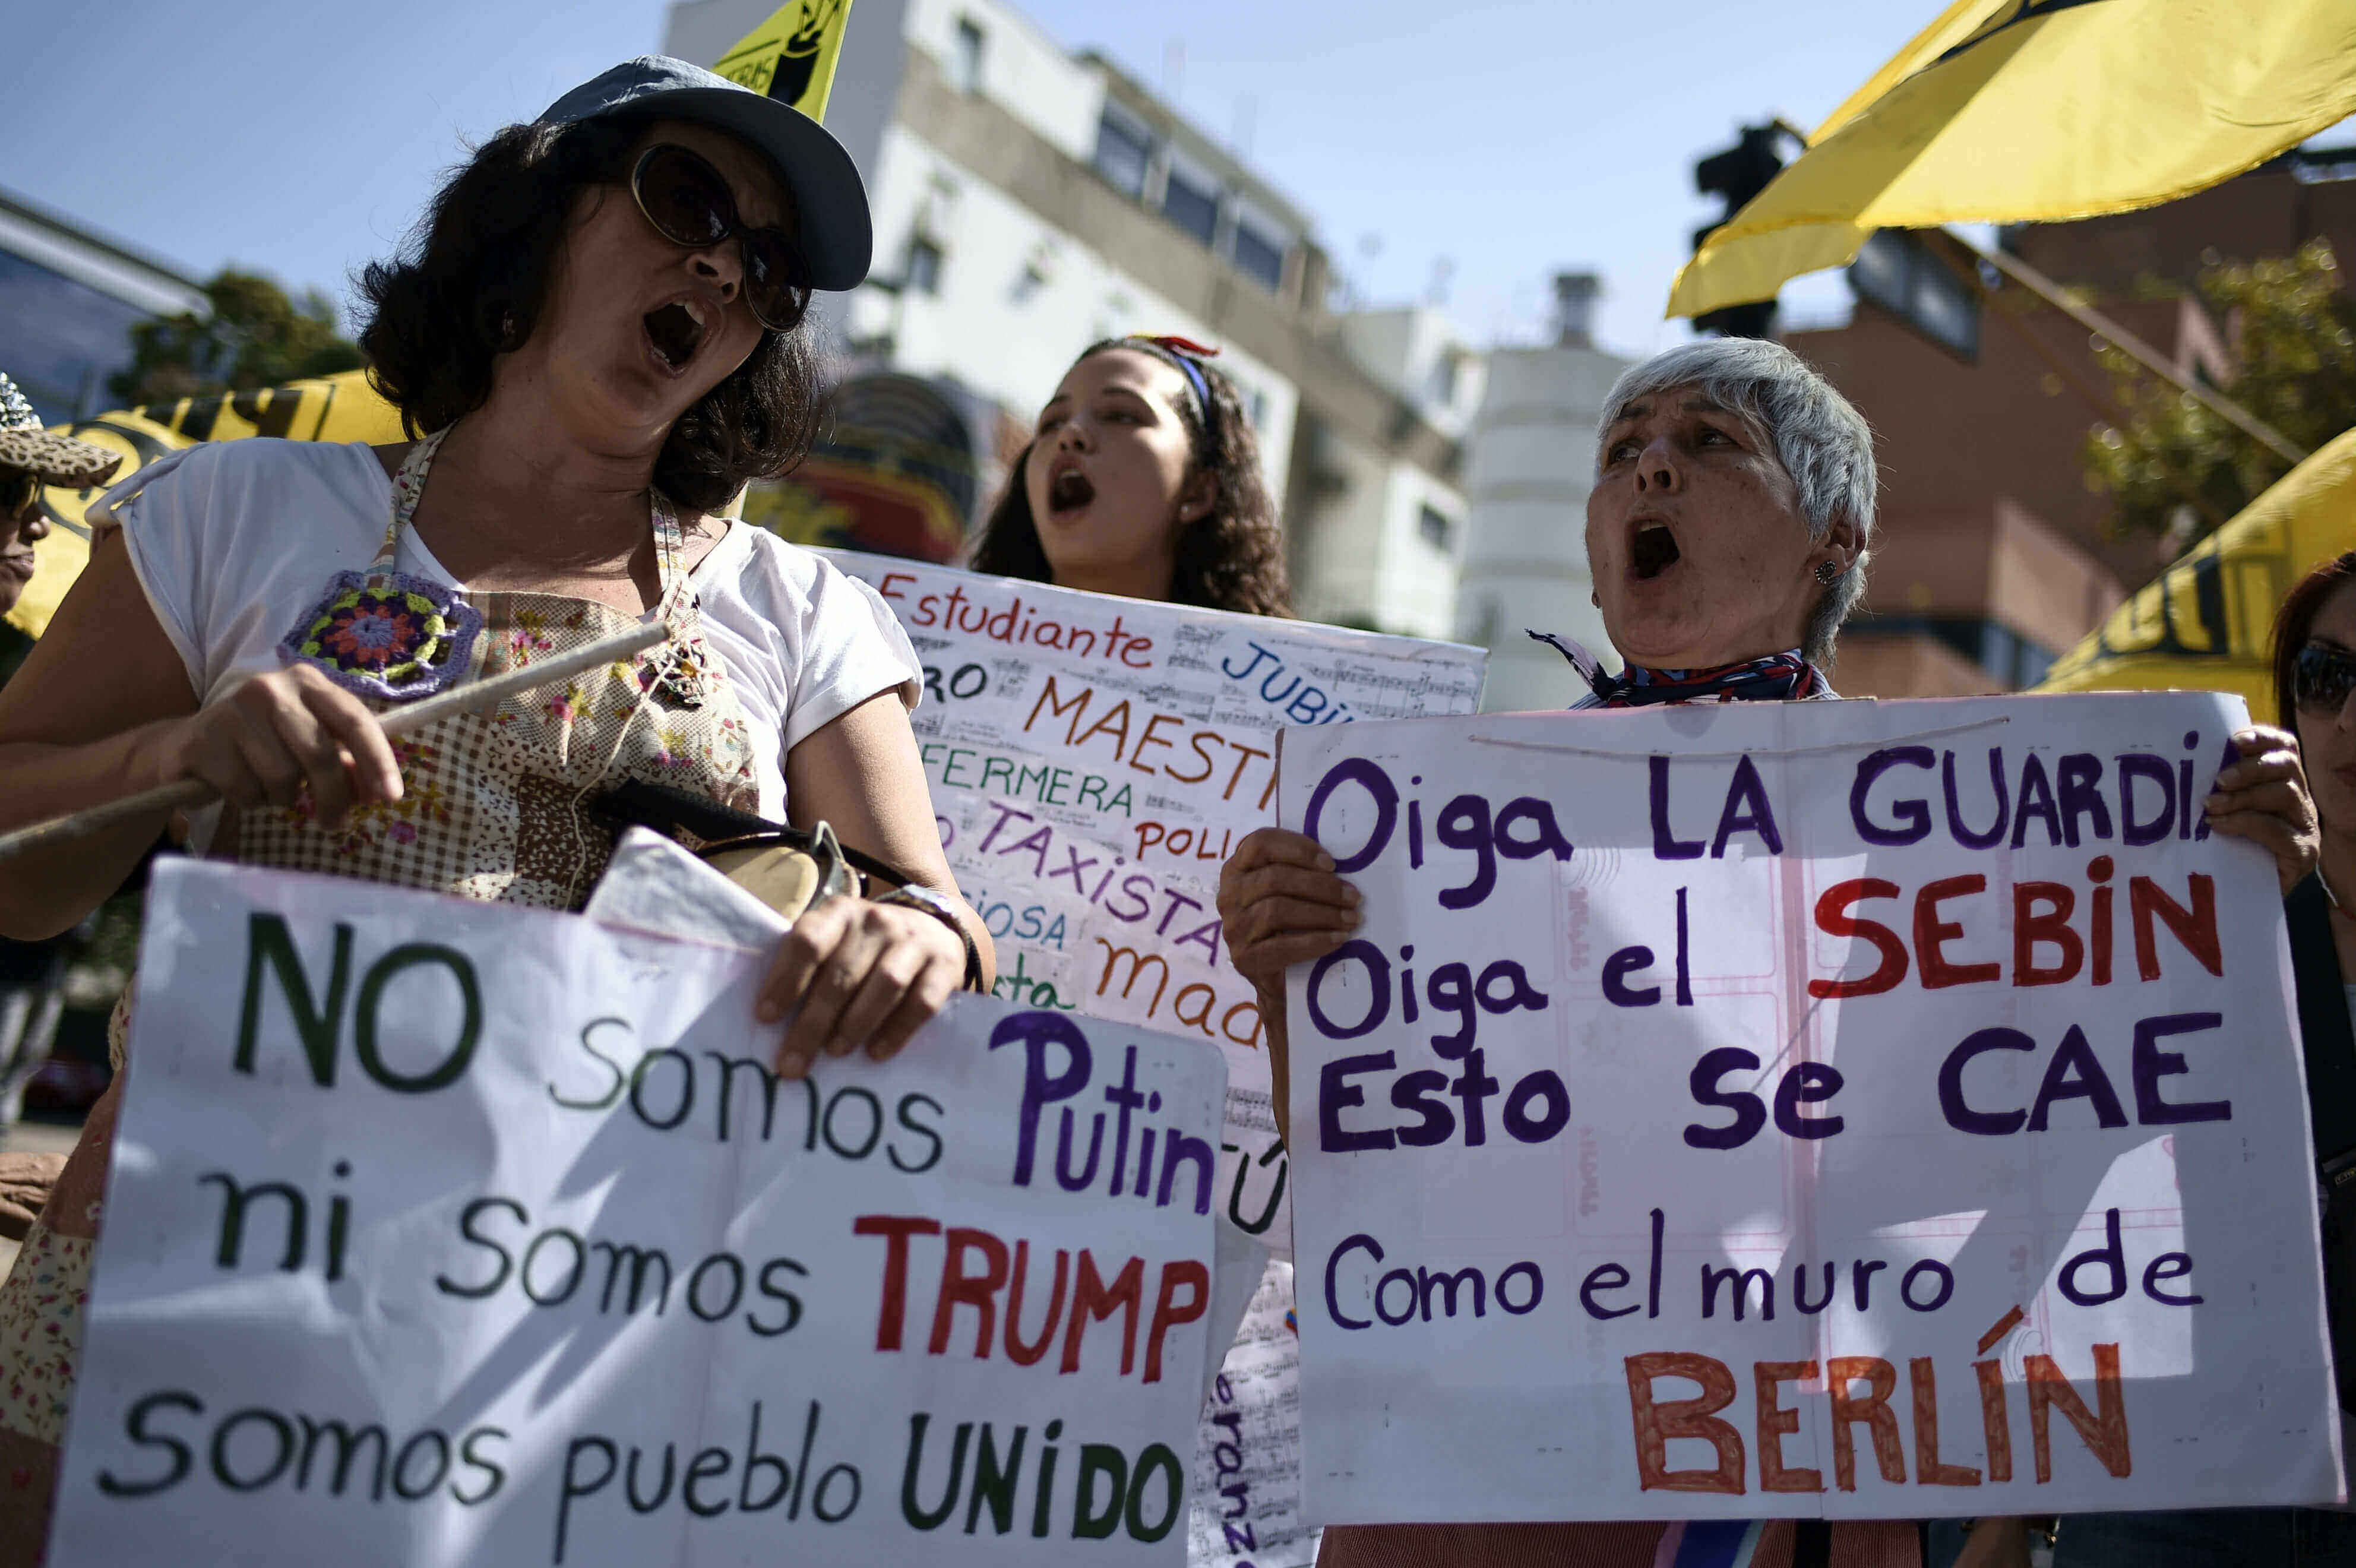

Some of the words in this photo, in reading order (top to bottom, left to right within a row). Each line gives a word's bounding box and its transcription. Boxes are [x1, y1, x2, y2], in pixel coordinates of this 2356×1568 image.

[880, 573, 1153, 669] Estudiante
[1135, 821, 1251, 861] POLI
[1304, 757, 1574, 910] Oiga
[1649, 754, 1784, 860] LA
[1307, 939, 1549, 1060] Oiga
[1602, 886, 1694, 1007] el
[233, 912, 483, 1093] NO
[988, 1010, 1215, 1216] Putin
[1320, 1048, 1571, 1153] Esto
[1938, 1012, 2232, 1136] CAE
[198, 1161, 353, 1283] ni
[853, 1215, 1210, 1384] TRUMP
[1325, 1234, 1544, 1330] Como
[1580, 1208, 1664, 1320] el
[1701, 1259, 1954, 1321] muro
[2057, 1208, 2204, 1306] de
[1623, 1304, 2132, 1495] BERLÍN
[553, 1401, 862, 1566] pueblo
